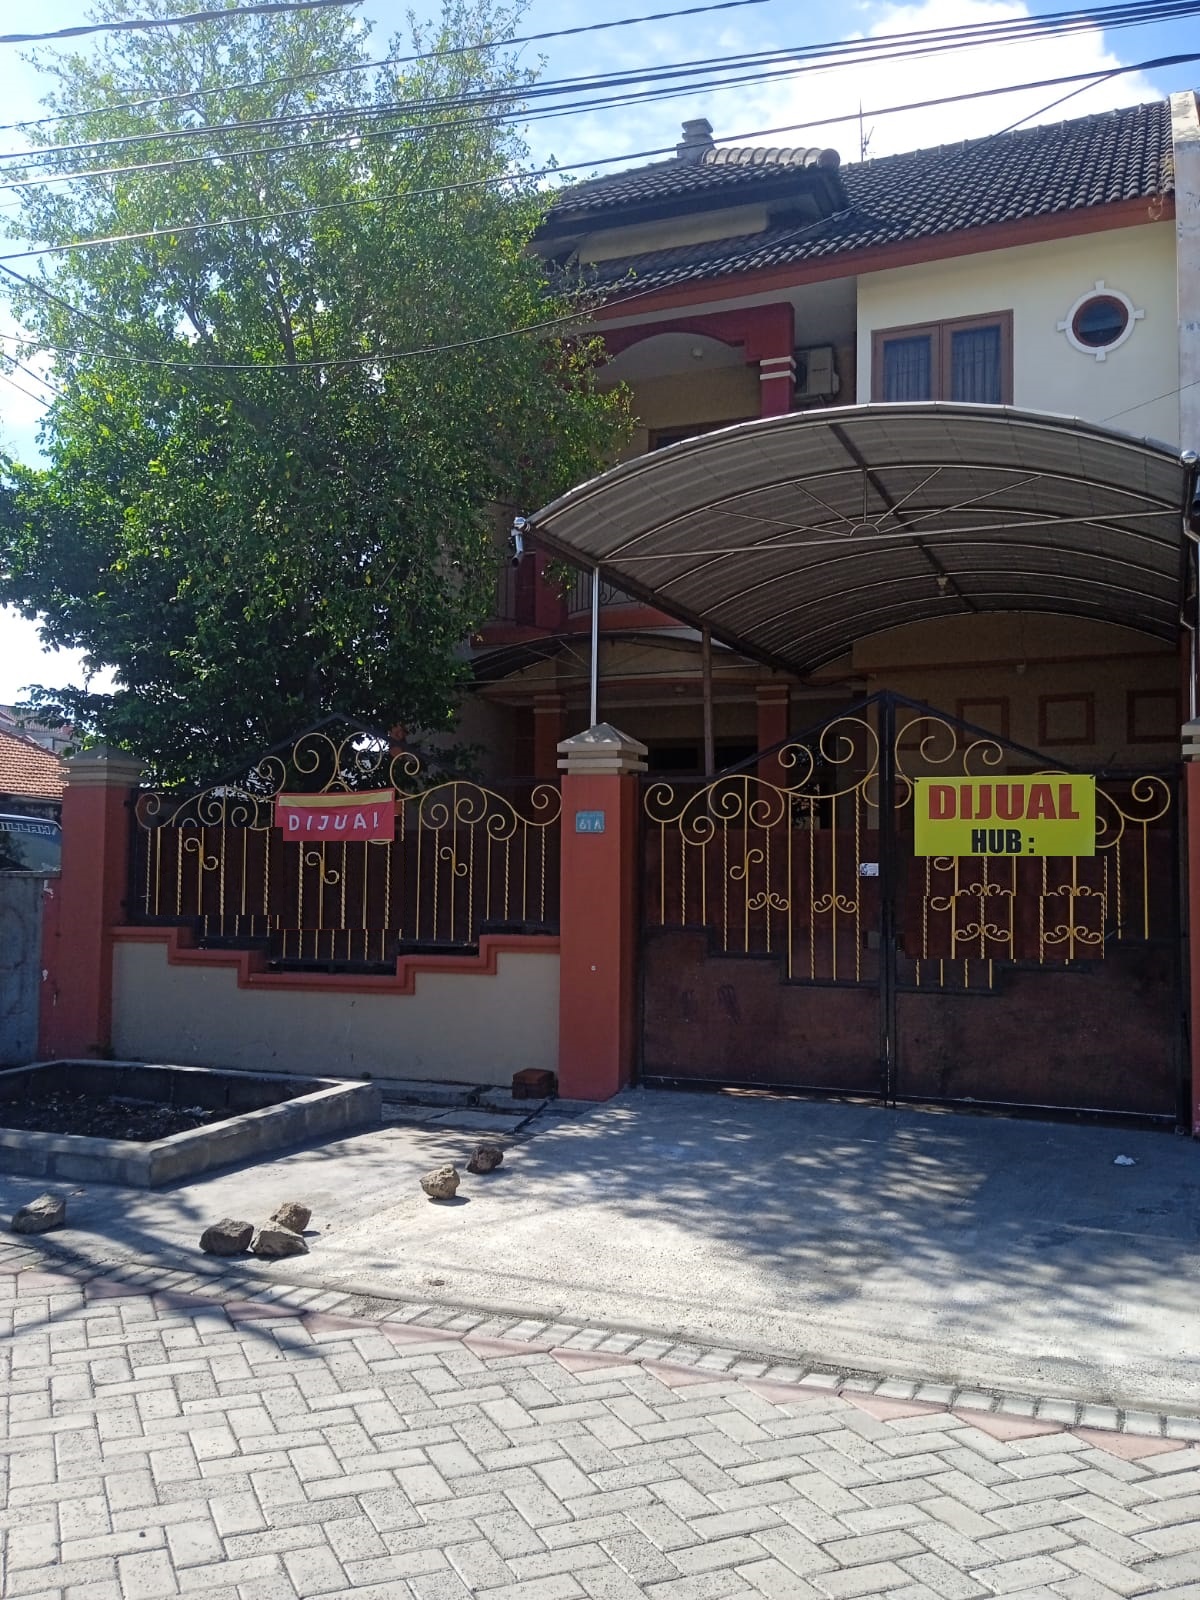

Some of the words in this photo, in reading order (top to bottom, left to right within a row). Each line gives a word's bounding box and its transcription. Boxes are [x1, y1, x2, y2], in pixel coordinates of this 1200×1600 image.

[928, 783, 1080, 820] DIJUAL
[0, 821, 51, 835] ILLAH
[971, 829, 1022, 854] HUB
